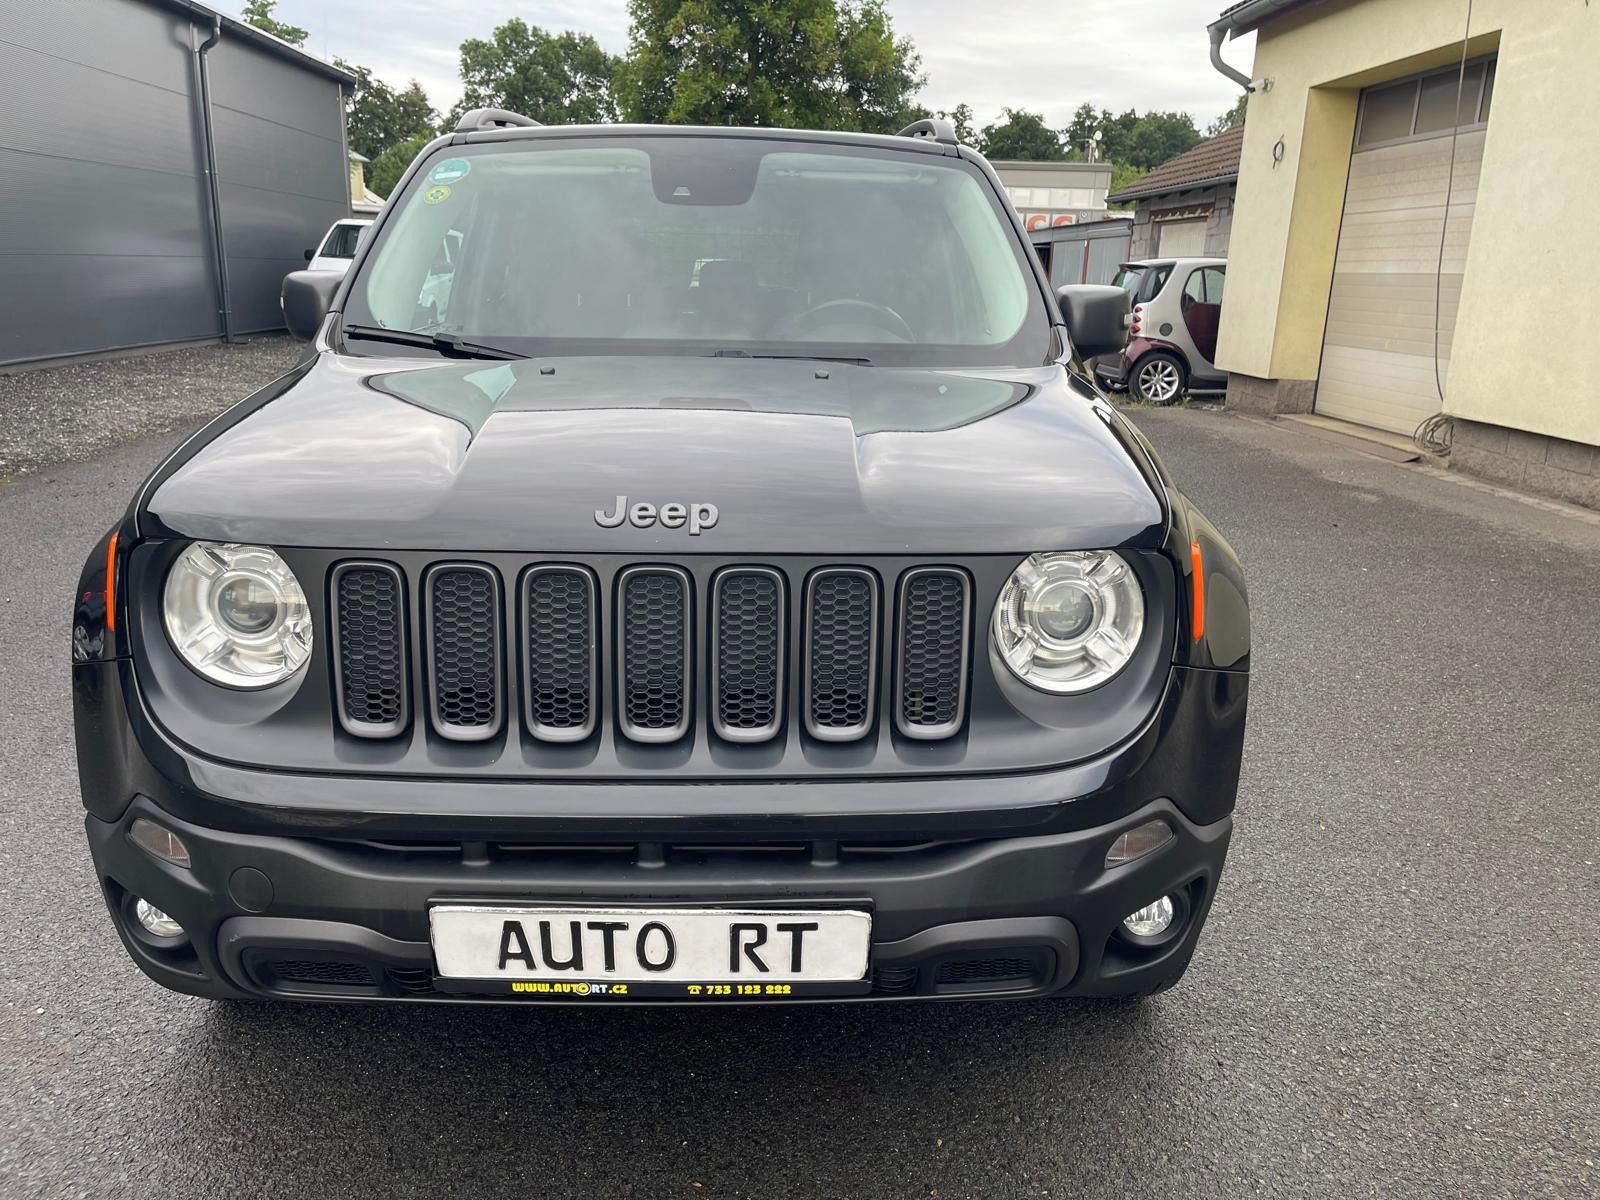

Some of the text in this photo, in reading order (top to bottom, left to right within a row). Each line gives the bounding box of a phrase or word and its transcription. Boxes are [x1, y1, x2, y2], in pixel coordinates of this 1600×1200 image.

[594, 495, 719, 536] Jeep
[498, 920, 819, 973] AUTO RT
[706, 984, 792, 995] 733 123 222
